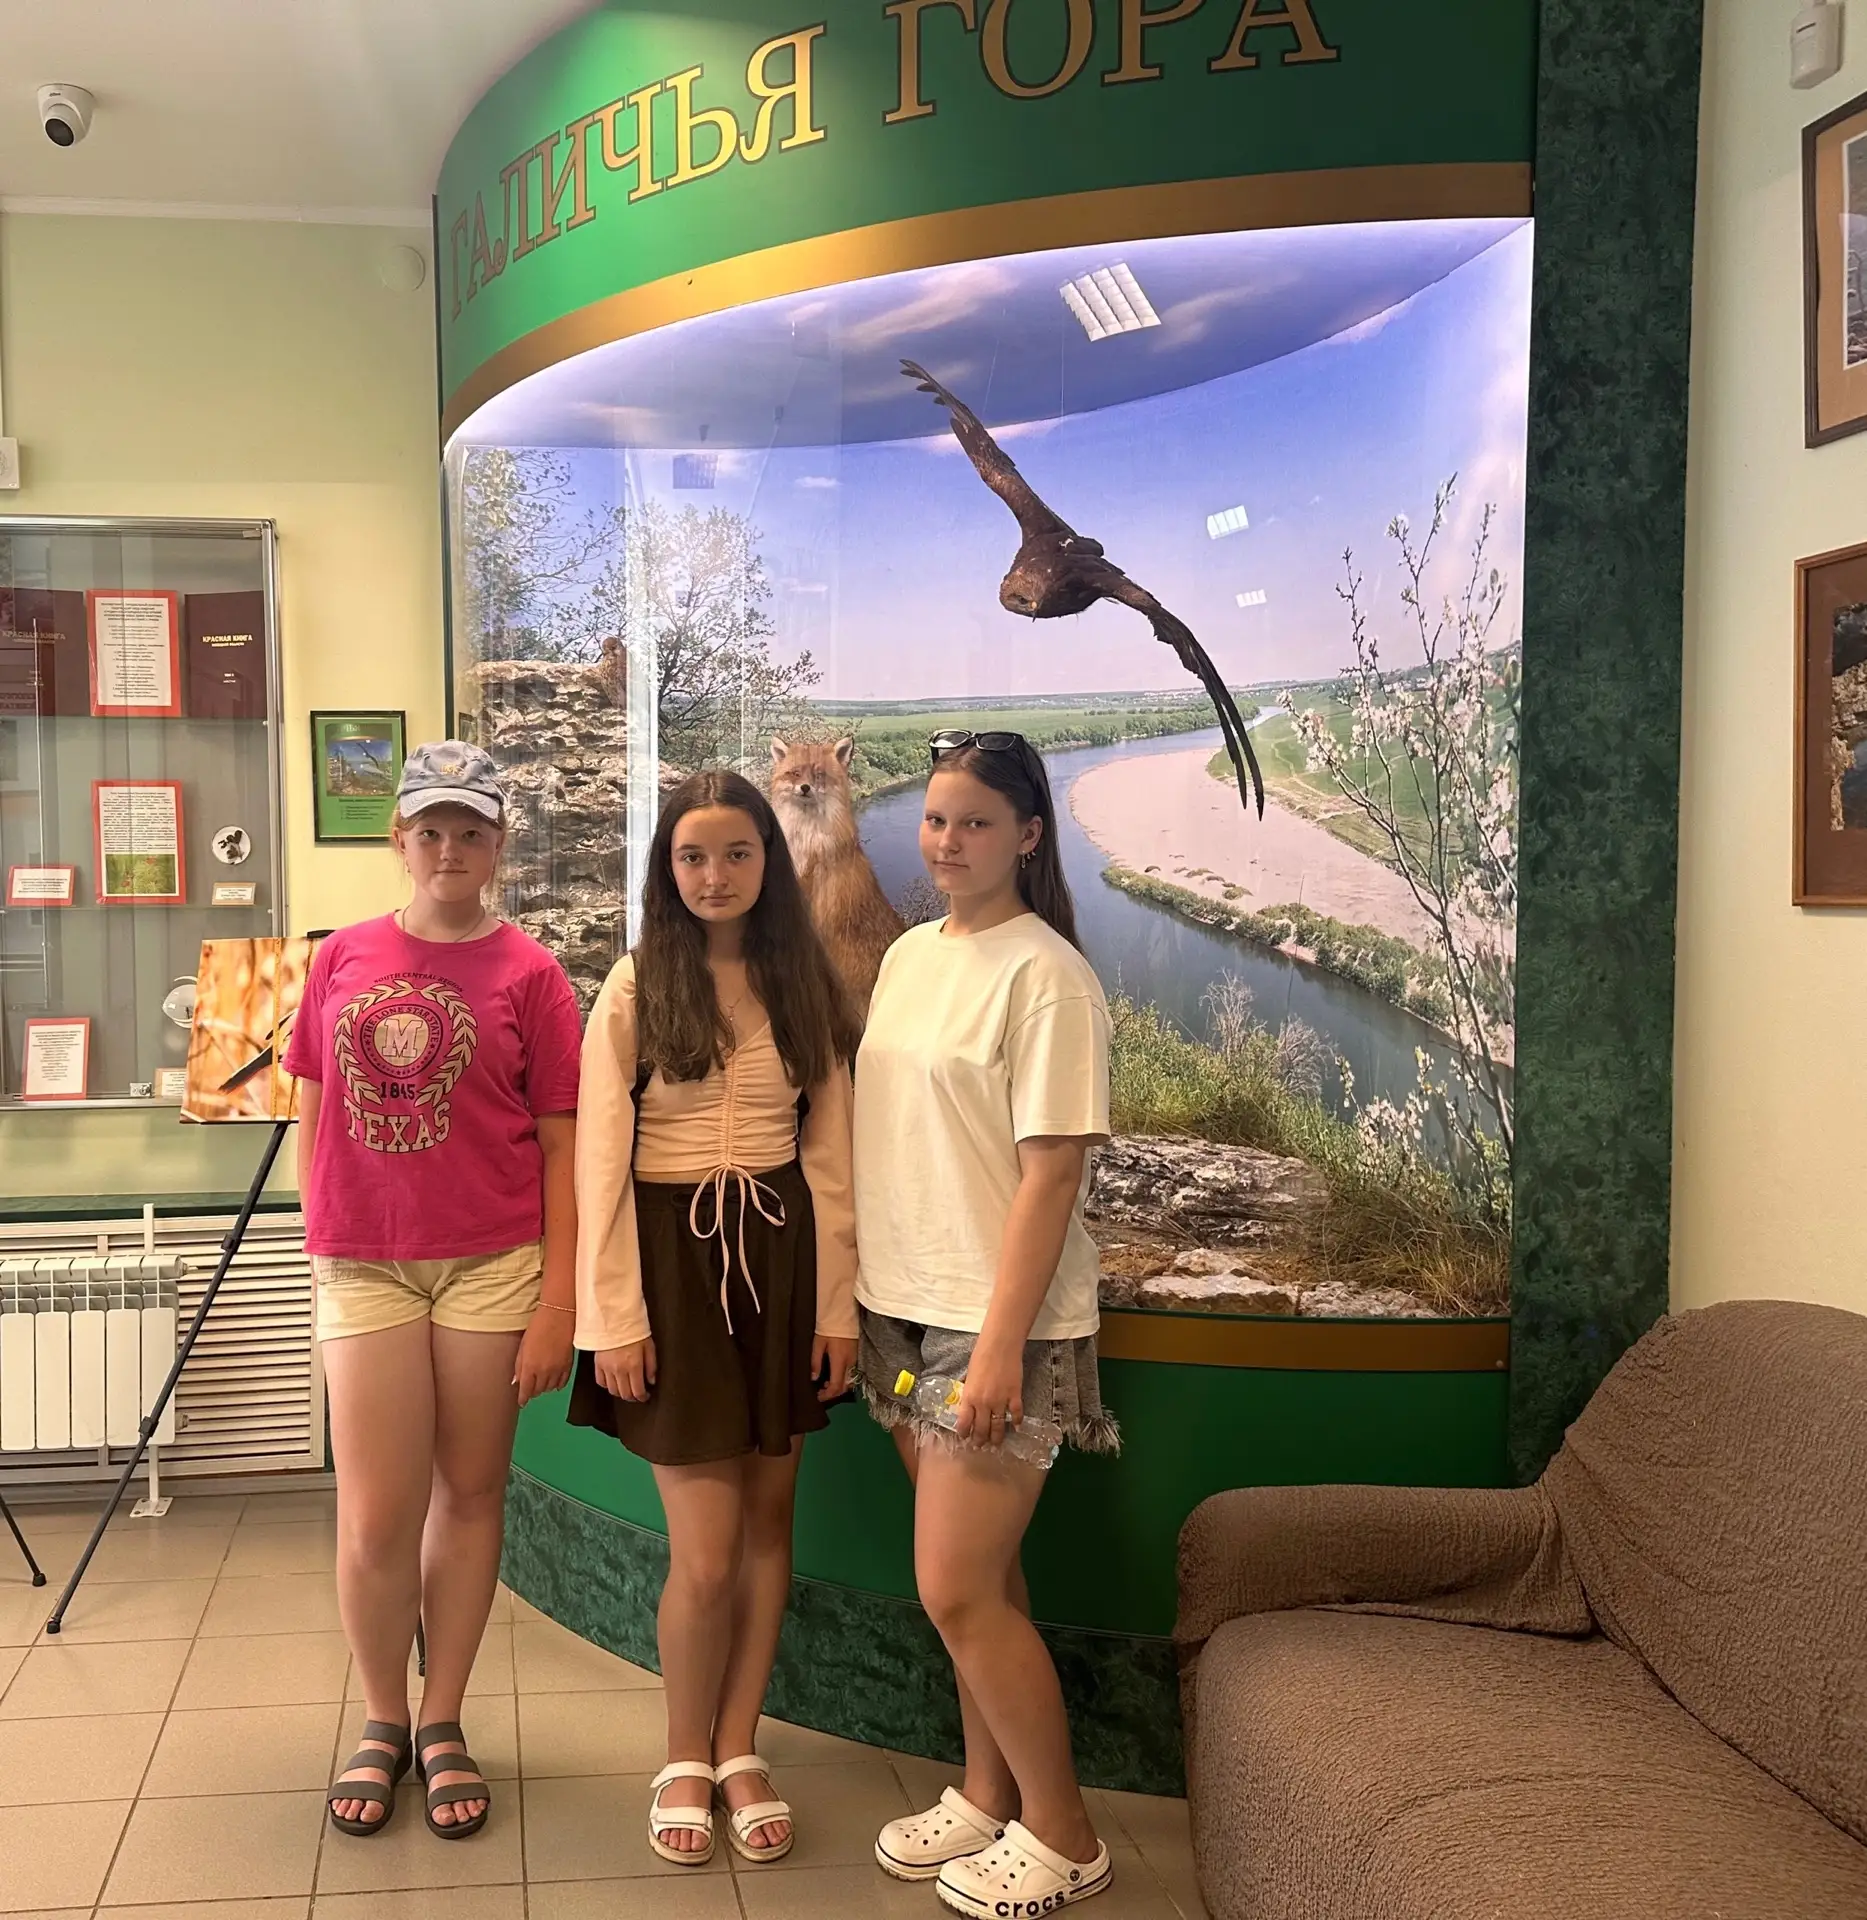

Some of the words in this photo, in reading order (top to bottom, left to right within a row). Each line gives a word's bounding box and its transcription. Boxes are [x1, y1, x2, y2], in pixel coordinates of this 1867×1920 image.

[450, 21, 827, 322] ГАЛИЧЬЯ
[882, 0, 1342, 125] ГОРА
[202, 634, 232, 643] КРАСНАЯ
[232, 633, 253, 642] КНИГА
[374, 972, 401, 983] SOUTH
[402, 971, 437, 981] CENTRAL
[363, 1020, 376, 1039] THE
[375, 1006, 404, 1021] LONE
[407, 1006, 430, 1019] STAR
[427, 1016, 440, 1043] STATE
[382, 1018, 423, 1058] M
[380, 1082, 415, 1100] 1845
[343, 1094, 451, 1153] TEXAS
[995, 1891, 1065, 1918] crocs
